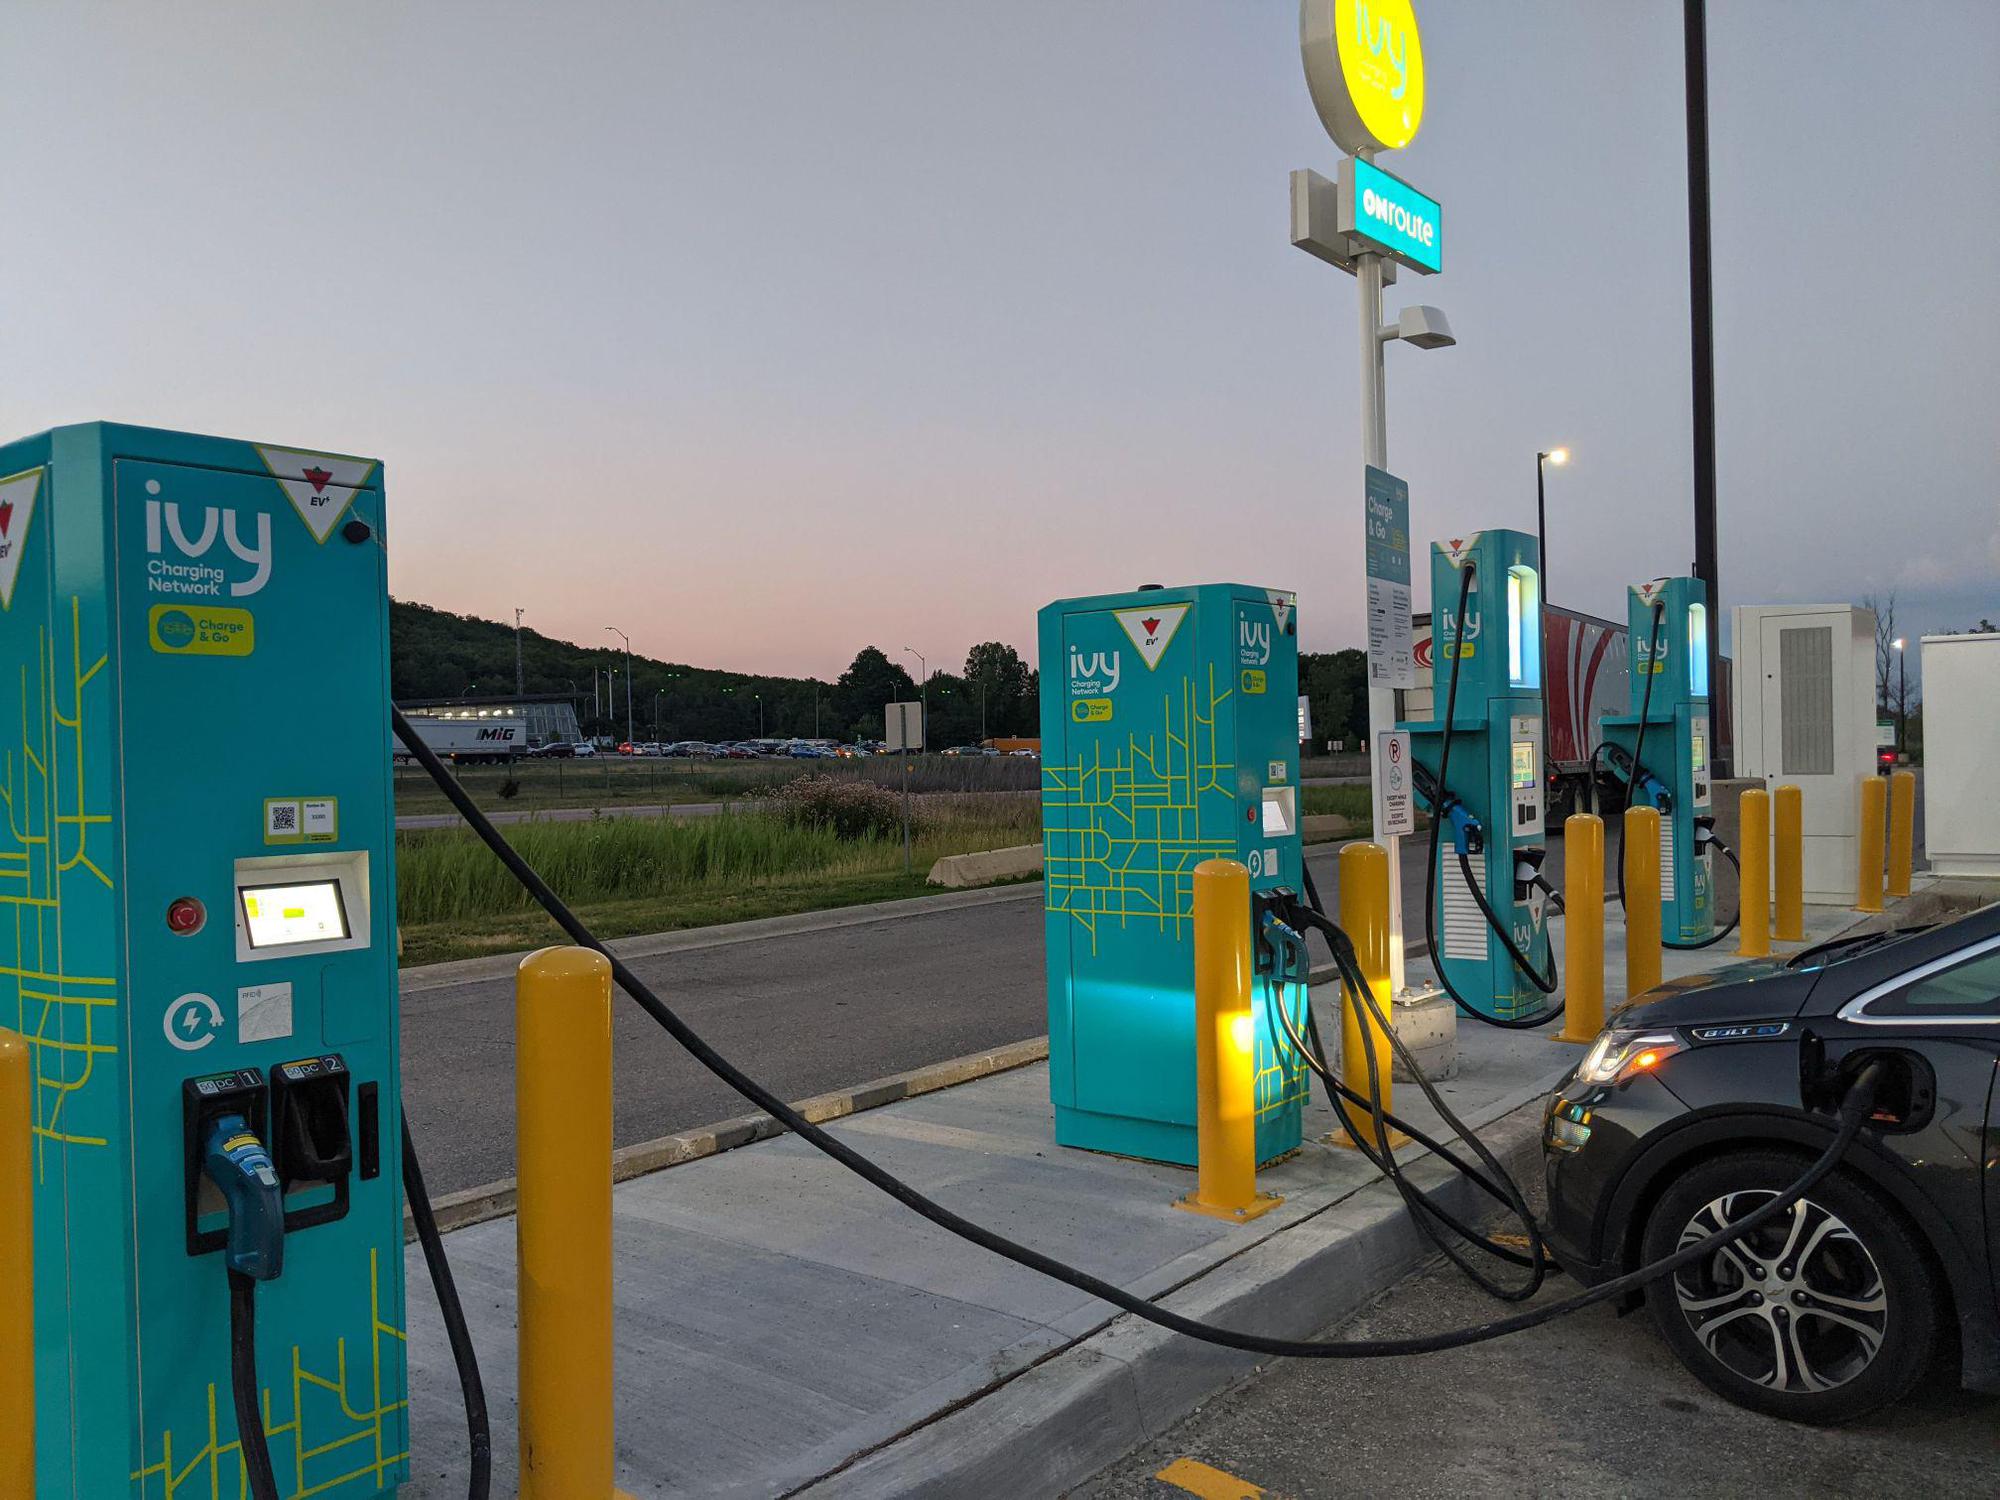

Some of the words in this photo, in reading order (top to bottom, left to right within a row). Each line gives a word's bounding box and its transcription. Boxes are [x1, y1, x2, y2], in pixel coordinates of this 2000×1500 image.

[1368, 496, 1393, 522] Charge
[145, 479, 272, 597] ivy
[1369, 518, 1375, 536] &
[1375, 521, 1386, 539] Go
[147, 560, 224, 583] Charging
[148, 577, 220, 596] Network
[199, 619, 244, 633] Charge
[200, 632, 208, 641] &
[212, 632, 230, 642] Go
[1240, 611, 1270, 665] ivy
[1070, 645, 1120, 693] ivy
[1071, 680, 1101, 688] Charging
[302, 1064, 319, 1073] DC
[325, 1058, 340, 1071] 2
[216, 1078, 235, 1088] DC
[243, 1072, 255, 1085] 1
